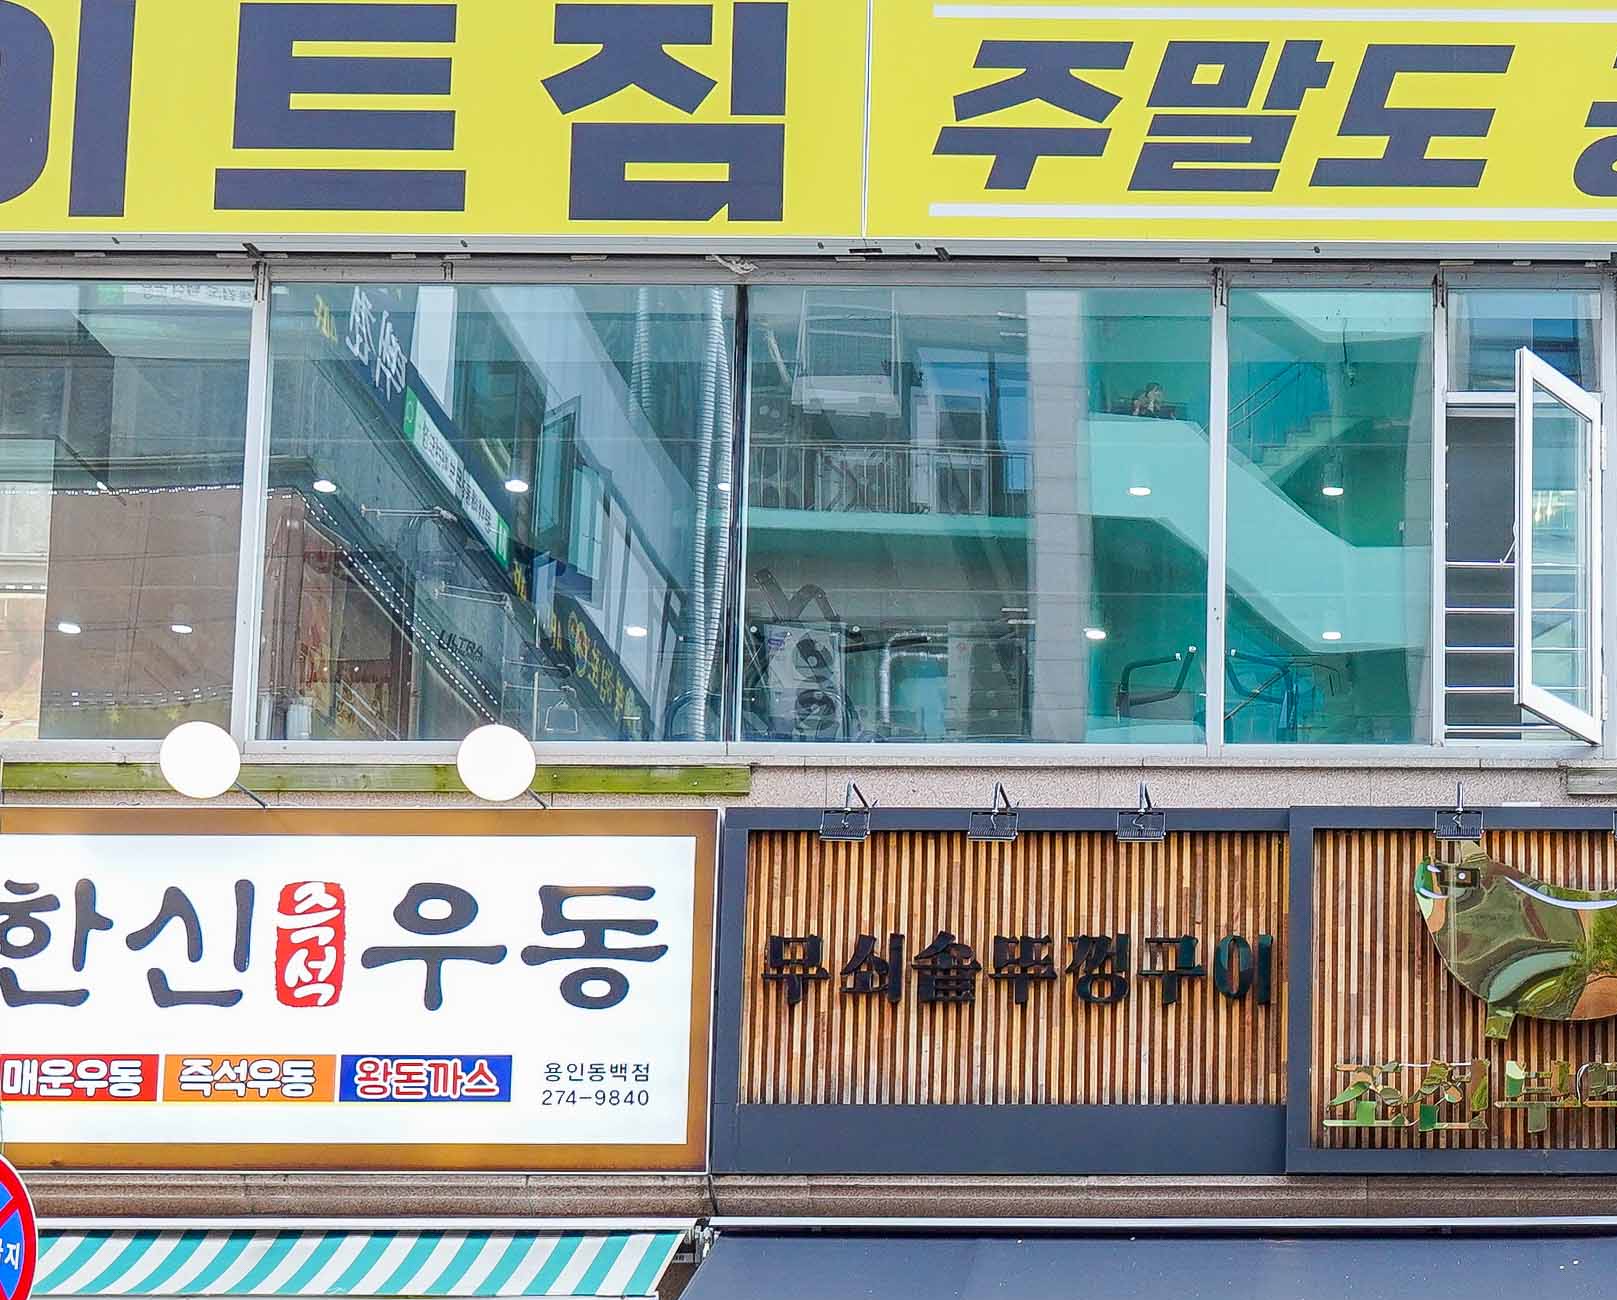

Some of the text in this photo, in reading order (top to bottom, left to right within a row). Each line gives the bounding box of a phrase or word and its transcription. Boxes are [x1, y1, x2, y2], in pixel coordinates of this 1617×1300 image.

[932, 40, 1513, 191] 주말도
[0, 878, 255, 1008] 한신
[361, 882, 669, 1010] 우동
[2, 1058, 143, 1098] 매운우동
[177, 1058, 316, 1098] 즉석우동
[354, 1057, 501, 1099] 왕돈까스
[543, 1062, 652, 1084] 용인동백점
[541, 1088, 651, 1108] 274-9840
